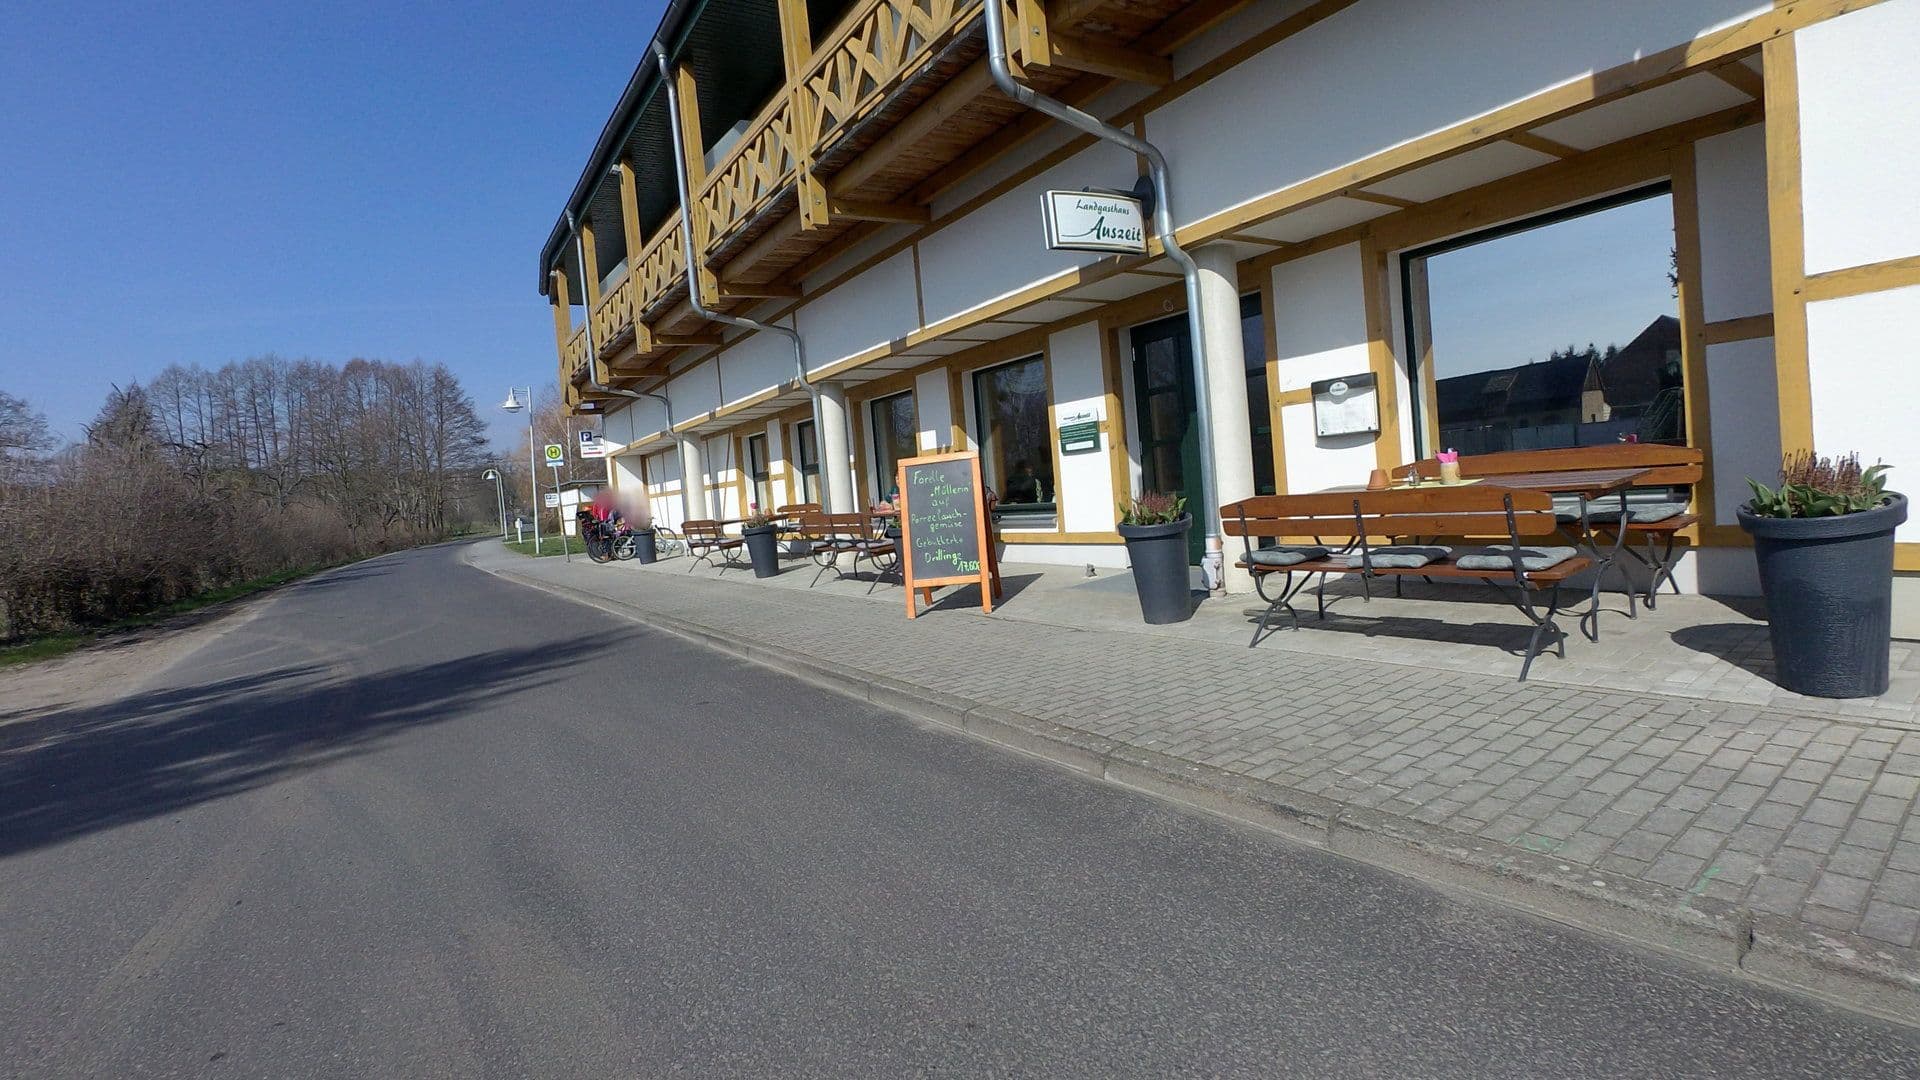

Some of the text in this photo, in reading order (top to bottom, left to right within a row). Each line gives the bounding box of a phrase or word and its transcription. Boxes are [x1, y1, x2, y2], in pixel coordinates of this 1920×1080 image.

[1076, 199, 1130, 216] Landgasthaus
[1082, 216, 1141, 242] Auszeit
[913, 469, 945, 485] Forelle
[931, 497, 949, 508] auf
